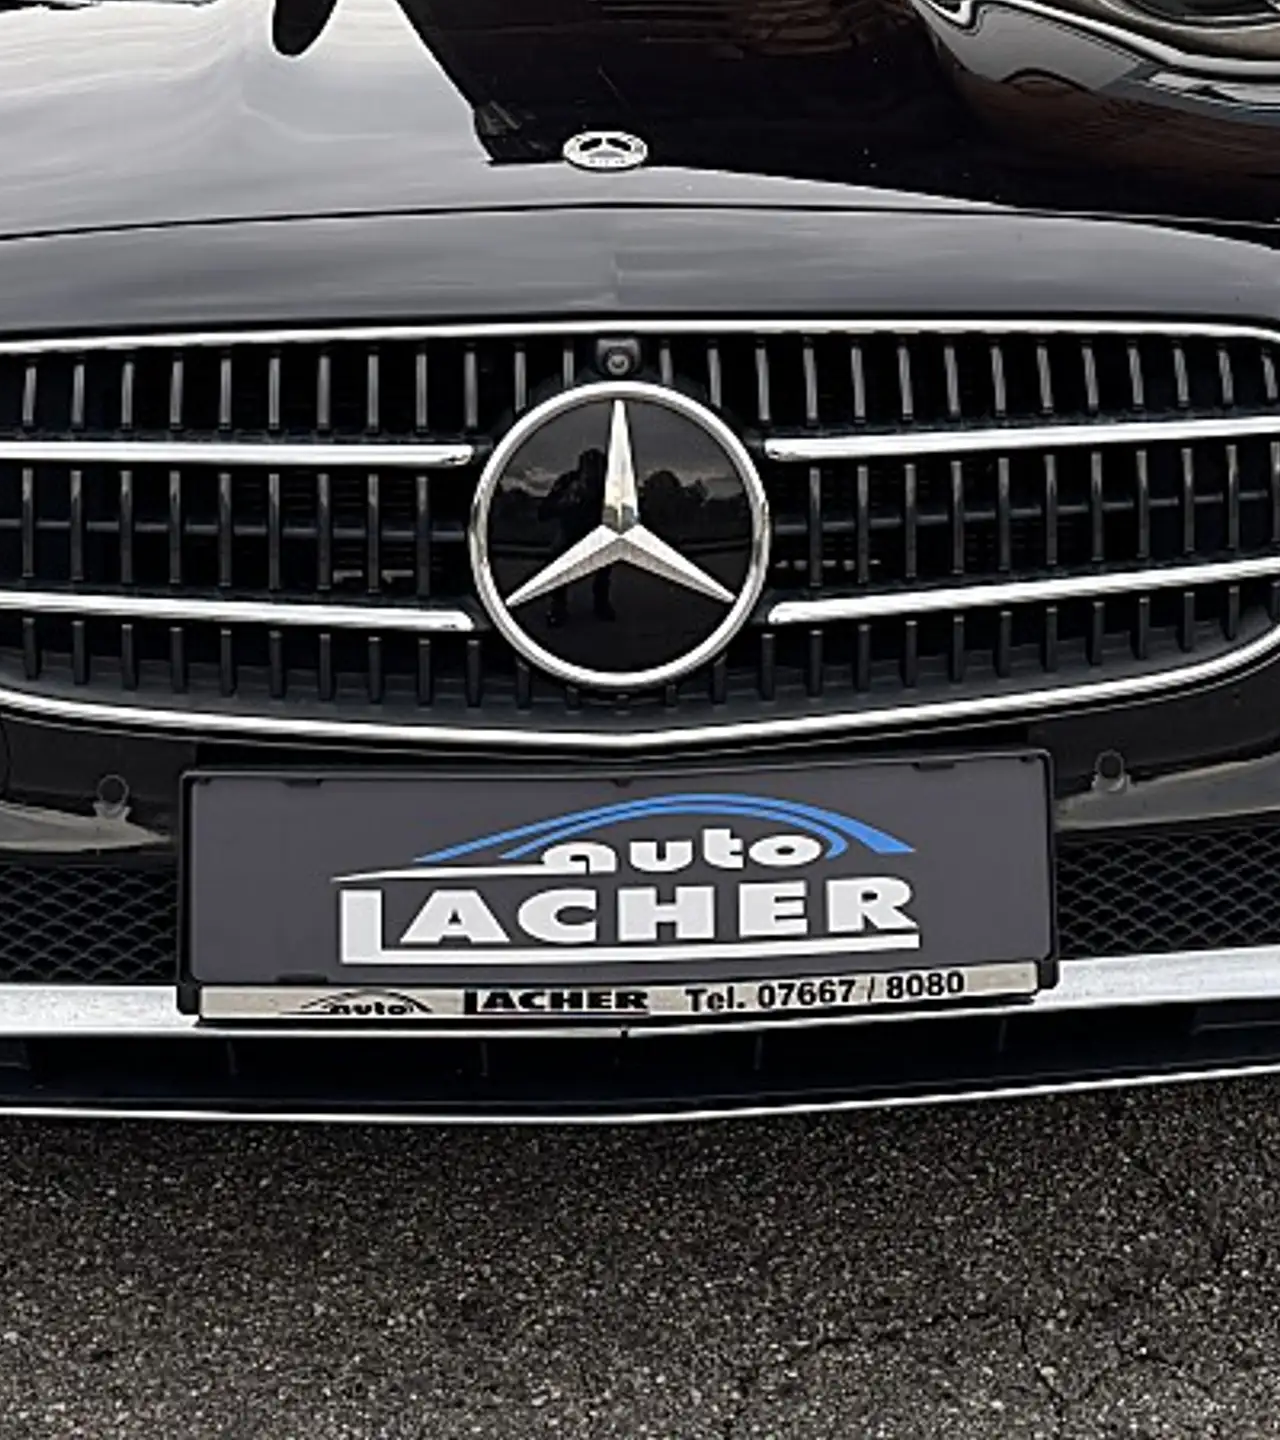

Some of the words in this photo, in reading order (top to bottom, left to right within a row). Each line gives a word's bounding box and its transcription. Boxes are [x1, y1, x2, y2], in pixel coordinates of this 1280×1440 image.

[535, 827, 824, 875] auto
[339, 876, 920, 965] LACHER
[327, 1000, 409, 1016] auto
[463, 989, 650, 1016] LACHER
[685, 986, 746, 1012] Tel.
[757, 978, 857, 1009] 07667
[885, 970, 965, 1000] 8080
